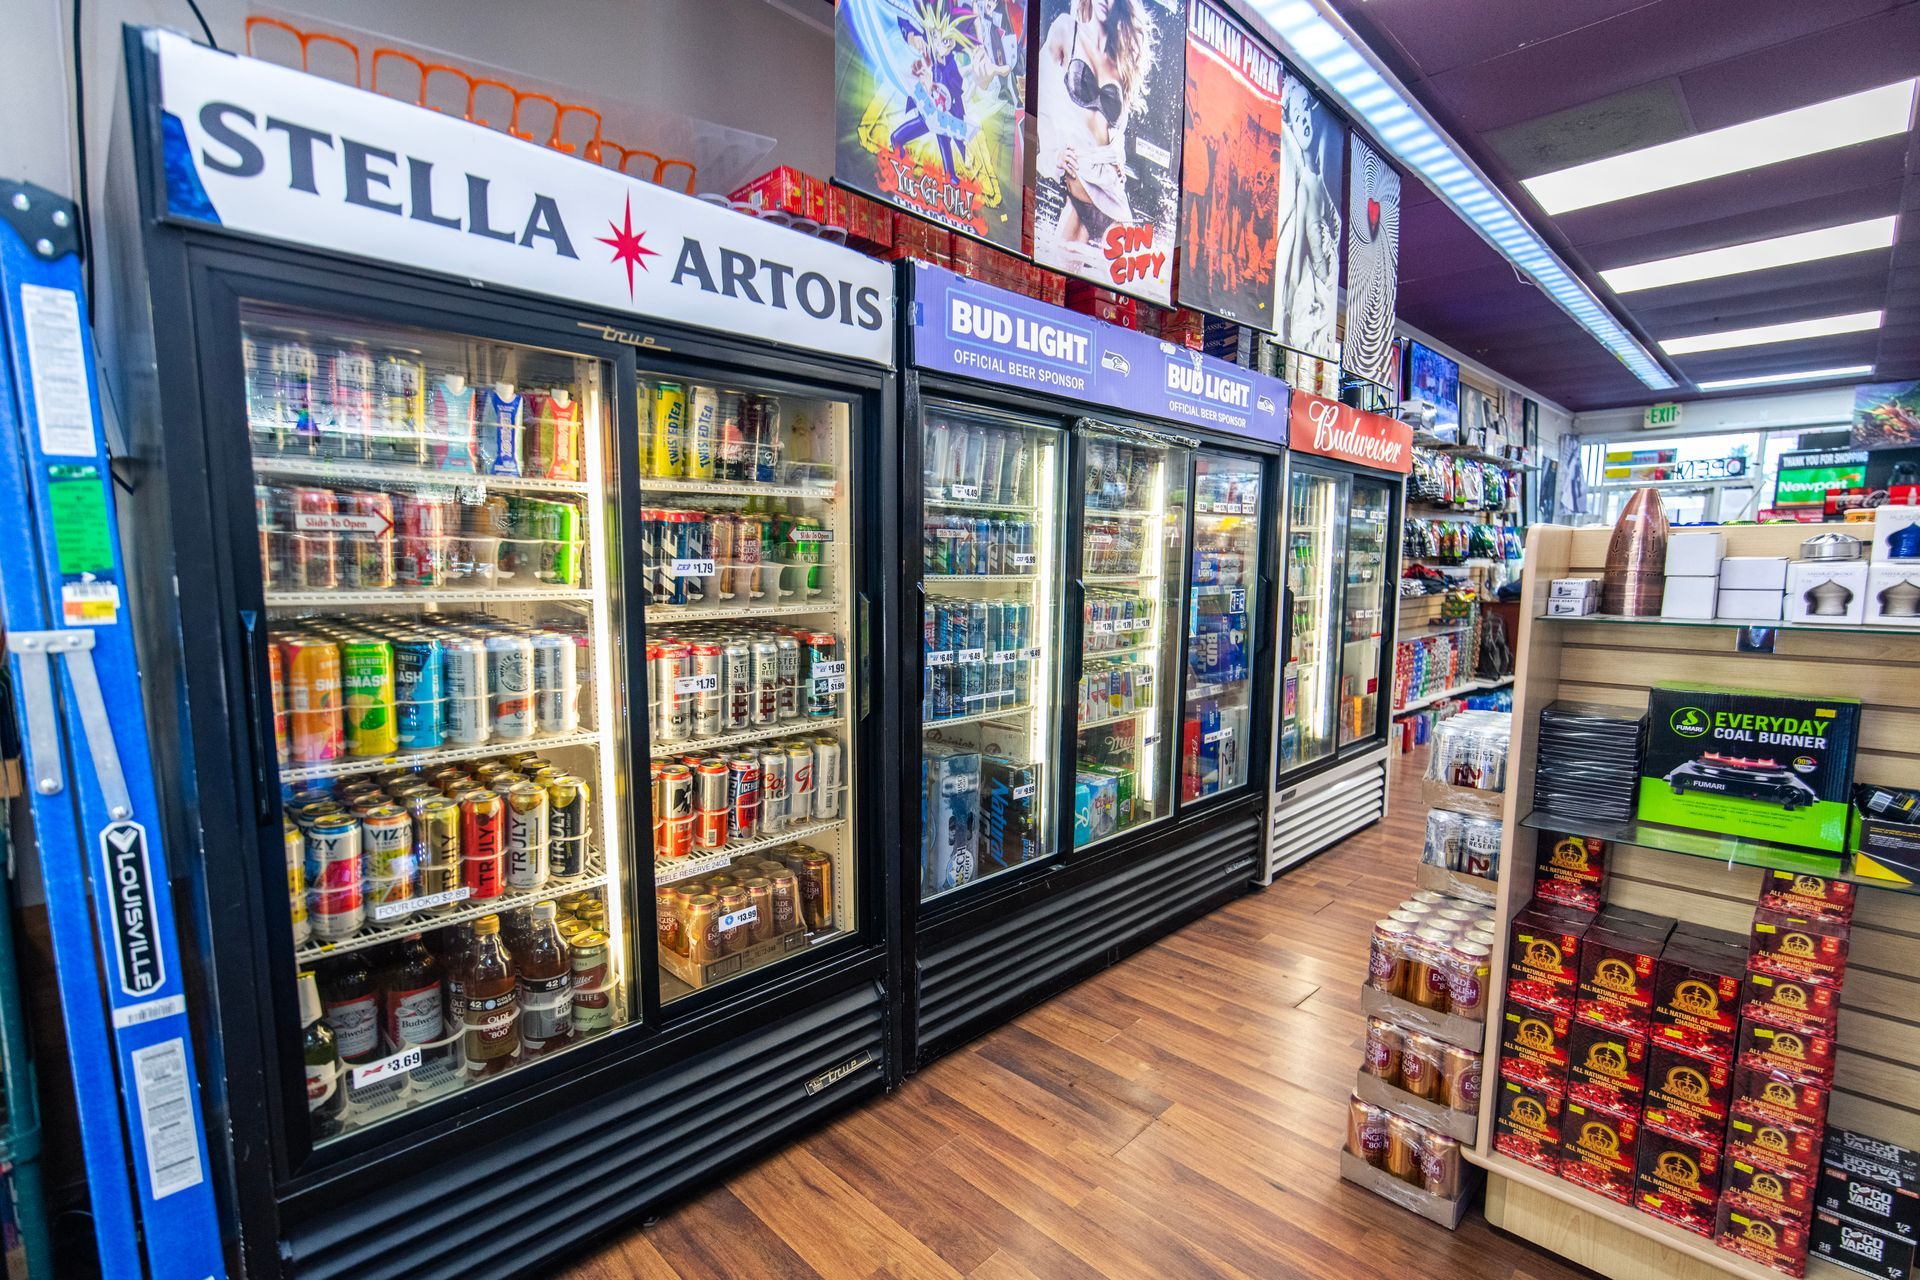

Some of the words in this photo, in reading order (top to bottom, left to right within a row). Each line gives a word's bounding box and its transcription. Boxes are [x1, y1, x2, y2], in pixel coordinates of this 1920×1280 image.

[1189, 0, 1241, 67] LINKIN
[1243, 38, 1280, 96] PARK
[889, 159, 974, 221] Yu-Gi-Oh!
[198, 101, 580, 260] STELLA
[671, 236, 883, 332] ARTOIS
[1104, 223, 1153, 260] SIN
[1110, 252, 1165, 284] CITY
[951, 298, 1012, 344] BUD
[1016, 321, 1088, 366] LIGHT
[954, 349, 1006, 373] OFFICIAL
[1008, 361, 1036, 379] BEER
[1038, 369, 1085, 390] SPONSOR
[1168, 362, 1203, 395] BUD
[1205, 374, 1250, 407] LIGHT
[668, 401, 682, 421] TEA
[699, 405, 714, 423] TEA
[1169, 400, 1199, 418] OFFICIAL
[1200, 407, 1217, 422] BEER
[1218, 411, 1246, 429] SPONSOR
[1650, 406, 1677, 424] EXIT
[1309, 400, 1403, 464] Budweiser
[667, 422, 680, 466] TWISED
[698, 425, 710, 468] TWISED
[1783, 454, 1804, 467] THANK
[1806, 455, 1819, 466] YOU
[1820, 454, 1833, 465] FOR
[1834, 451, 1869, 464] SHOPPING
[964, 488, 978, 498] $4.49
[1779, 479, 1849, 493] Newport
[305, 518, 328, 527] Slide
[344, 518, 367, 529] Open
[693, 563, 713, 574] $1.79
[940, 653, 953, 662] $6.49
[968, 652, 981, 662] $6.49
[1003, 652, 1016, 661] $6.49
[1207, 633, 1218, 666] BUD
[500, 655, 512, 677] WHITE
[828, 663, 845, 673] $1.99
[345, 675, 389, 687] SMASH
[696, 677, 716, 691] $1.79
[1676, 724, 1703, 733] FUMARI
[1715, 712, 1830, 737] EVERYDAY
[1105, 736, 1135, 752] Mill
[1714, 727, 1754, 742] COAL
[1758, 732, 1826, 749] BURNER
[1693, 780, 1725, 790] FUMARI
[551, 808, 566, 864] TRULY
[479, 825, 495, 886] TRULY
[512, 818, 528, 875] TRULY
[679, 863, 711, 878] RESERVE
[379, 902, 410, 917] FOUR
[411, 894, 441, 909] LOKO
[442, 888, 467, 902] $2.89
[117, 852, 153, 992] LOUISVILLE
[737, 910, 756, 921] $13.99
[1451, 960, 1471, 973] 24
[1512, 963, 1522, 971] ALL
[1522, 966, 1547, 979] NATURAL
[1545, 973, 1573, 986] COCONUT
[546, 980, 559, 988] 42
[1527, 975, 1556, 988] CHARCOAL
[1580, 983, 1591, 992] ALL
[1591, 987, 1619, 1000] NATURAL
[1619, 994, 1648, 1008] COCONUT
[1596, 994, 1628, 1009] CHARCOAL
[469, 1001, 482, 1009] 42
[487, 1012, 510, 1024] OLDE
[1656, 1006, 1669, 1015] ALL
[1669, 1009, 1698, 1023] NATURAL
[1700, 1018, 1731, 1033] COCONUT
[1674, 1018, 1710, 1034] CHARCOAL
[1504, 1041, 1514, 1050] ALL
[387, 1052, 420, 1071] $3.69
[1573, 1065, 1583, 1074] ALL
[1584, 1069, 1610, 1083] NATURAL
[1610, 1078, 1639, 1093] COCONUT
[1589, 1077, 1620, 1092] CHARCOAL
[1649, 1089, 1661, 1098] ALL
[1661, 1094, 1691, 1109] NATURAL
[1691, 1104, 1722, 1120] COCONUT
[1666, 1102, 1701, 1119] CHARCOAL
[1565, 1143, 1576, 1152] ALL
[1640, 1173, 1652, 1183] ALL
[1652, 1178, 1681, 1194] NATURAL
[1682, 1188, 1713, 1206] COCONUT
[1658, 1186, 1692, 1204] CHARCOAL
[1827, 1197, 1839, 1206] 36
[1849, 1192, 1891, 1214] VAPOR
[1896, 1222, 1911, 1233] 1/2
[1819, 1242, 1831, 1251] 36
[1841, 1236, 1883, 1259] VAPOR
[1887, 1266, 1902, 1277] 1/2
